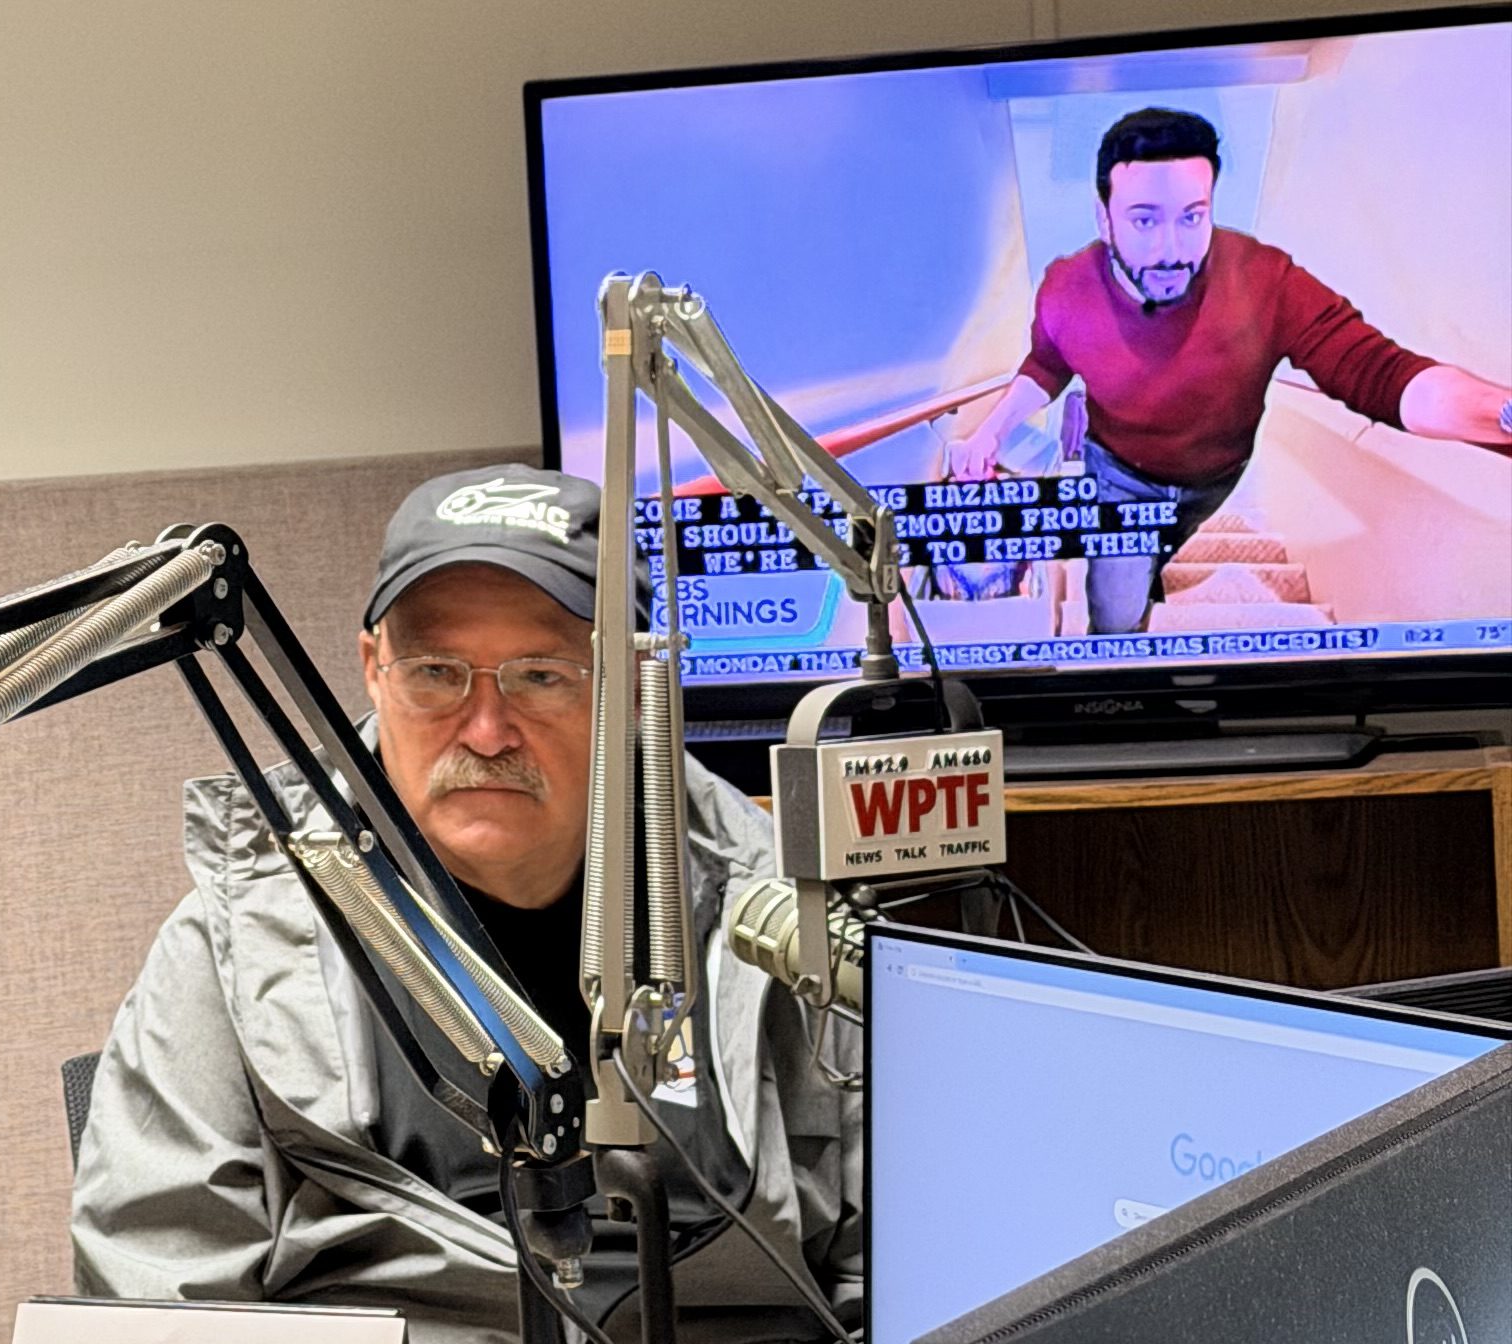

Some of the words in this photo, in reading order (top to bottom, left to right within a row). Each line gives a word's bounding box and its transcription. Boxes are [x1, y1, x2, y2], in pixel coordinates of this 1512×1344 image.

[720, 495, 741, 518] A
[925, 480, 1040, 506] HAZARD
[1057, 477, 1098, 501] SO
[683, 522, 795, 548] SHOULD
[893, 510, 1003, 538] EMOVED
[1020, 506, 1100, 531] FROM
[1117, 502, 1178, 527] THE
[704, 548, 798, 574] WE'RE
[926, 540, 966, 564] TO
[984, 536, 1062, 561] KEEP
[1080, 531, 1173, 557] THEM.
[656, 598, 799, 627] ORNINGS
[696, 654, 795, 675] MONDAY
[799, 651, 854, 671] THAT
[934, 644, 1017, 665] NERGY
[1020, 639, 1152, 661] CAROLINAS
[1155, 637, 1205, 656] HAS
[1207, 630, 1324, 655] REDUCED
[843, 758, 870, 778] FM
[931, 751, 958, 770] AM
[850, 772, 990, 838] WPTF
[845, 849, 883, 867] NEWS
[895, 845, 927, 862] TALK
[939, 839, 991, 857] TRAFFIC
[1171, 1132, 1263, 1182] Goo
